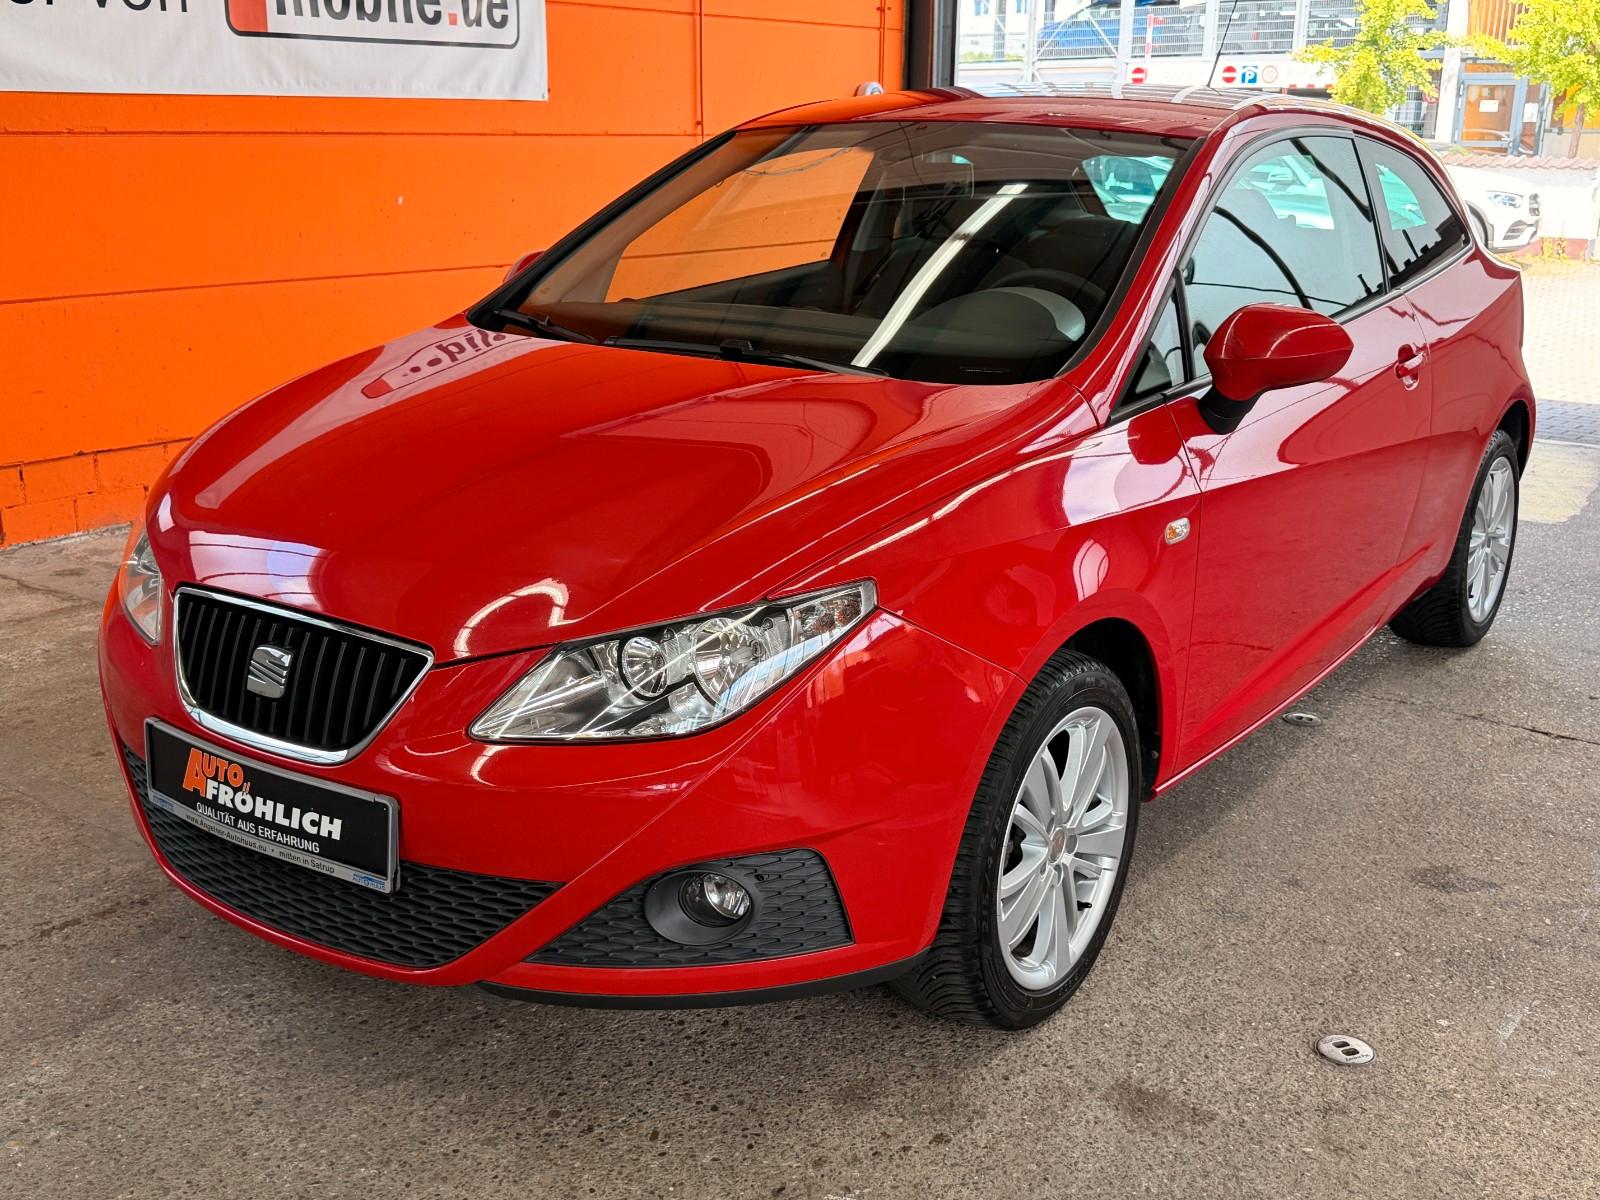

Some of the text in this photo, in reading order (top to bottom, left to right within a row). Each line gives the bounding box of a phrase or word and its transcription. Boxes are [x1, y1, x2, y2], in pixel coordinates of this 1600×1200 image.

[183, 747, 244, 797] AUTO
[196, 802, 235, 826] QUALITÄT
[237, 820, 256, 834] AUS
[258, 825, 320, 853] ERFAHRUNG
[206, 778, 342, 840] FRÖHLICH
[279, 850, 301, 863] mitten
[302, 857, 310, 865] in
[311, 859, 335, 874] Satrup
